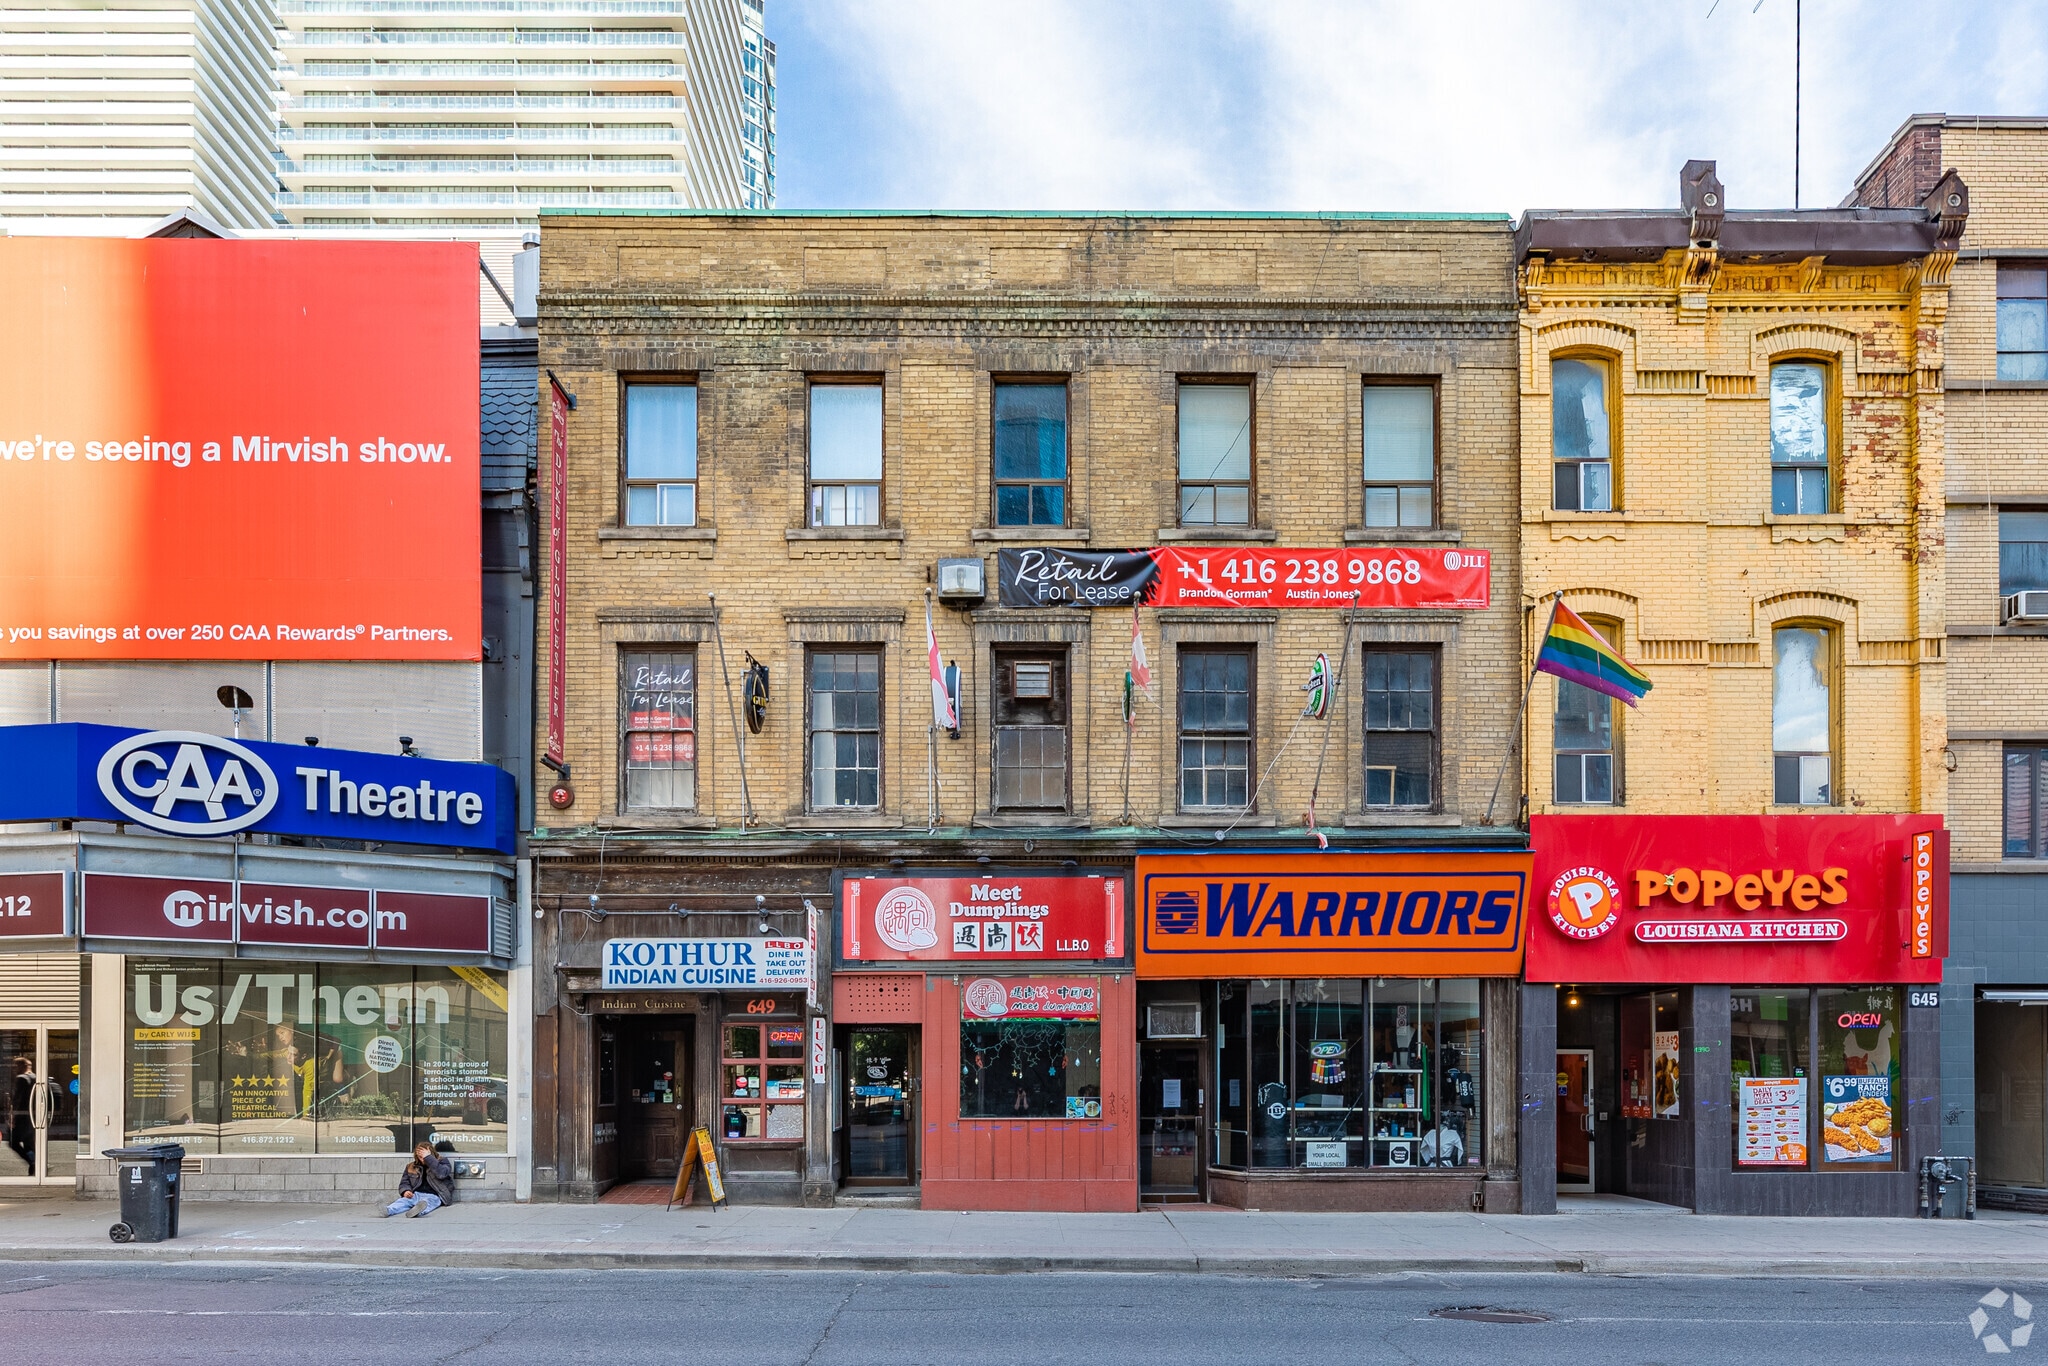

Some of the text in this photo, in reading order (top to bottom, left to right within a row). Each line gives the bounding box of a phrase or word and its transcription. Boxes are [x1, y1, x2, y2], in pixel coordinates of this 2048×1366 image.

[85, 435, 191, 468] seeing
[202, 441, 221, 462] a
[232, 435, 349, 462] Mirvish
[359, 436, 452, 462] show.
[553, 453, 562, 520] DUKE
[1014, 550, 1117, 586] Retail
[1177, 558, 1422, 584] +1 416 238 9868
[1038, 582, 1130, 600] For Lease
[1179, 587, 1224, 598] Brandon
[1286, 587, 1320, 599] Austin
[9, 627, 42, 643] you
[47, 624, 117, 643] savings
[122, 625, 141, 640] at
[146, 627, 186, 640] over
[191, 625, 224, 640] 250
[229, 625, 271, 641] CAA
[371, 625, 453, 641] Partners.
[296, 766, 483, 825] Theatre
[1550, 866, 1620, 899] LOUISIANA
[970, 884, 1022, 901] Meet
[1567, 882, 1604, 920] P
[163, 889, 407, 931] mirvish.com
[949, 902, 1049, 920] Dumplings
[1206, 882, 1516, 938] WARRIORS
[1552, 912, 1618, 938] KITCHEN
[1643, 923, 1839, 938] LOUISIANA KITCHEN
[1056, 939, 1089, 951] L.L.B.O
[609, 942, 756, 967] KOTHUR
[608, 968, 756, 984] INDIAN CUISINE
[766, 968, 806, 976] DELIVERY
[135, 974, 450, 1026] Us/Them
[602, 999, 686, 1009] Indian Cuisine
[747, 999, 775, 1014] 649
[1911, 992, 1938, 1007] 645
[1837, 1013, 1882, 1028] OPEN
[139, 1029, 196, 1038] by CARLY WIJS
[770, 1030, 803, 1041] OPEN
[377, 1039, 395, 1047] Direct
[813, 1019, 824, 1075] LUNCH
[1311, 1043, 1341, 1055] OPEN
